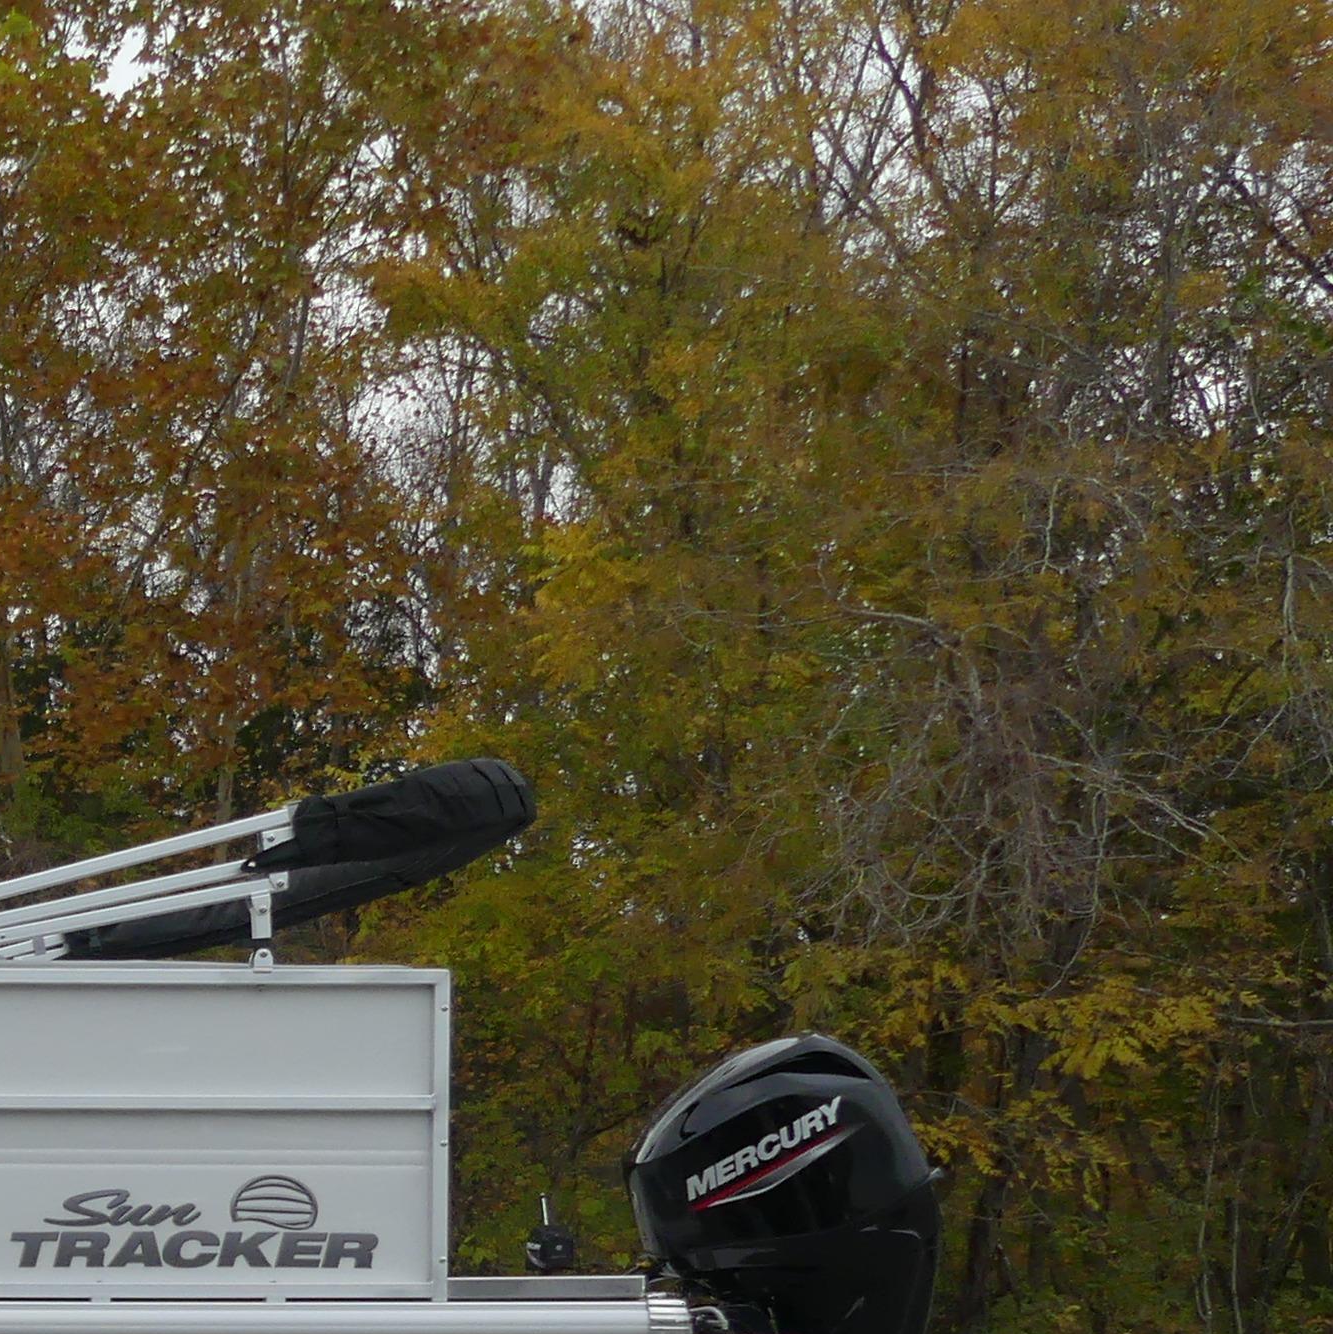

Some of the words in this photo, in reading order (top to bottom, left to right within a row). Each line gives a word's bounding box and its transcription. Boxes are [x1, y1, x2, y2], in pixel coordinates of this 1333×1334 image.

[685, 1096, 842, 1201] MERCURY
[43, 1188, 202, 1226] Sun
[10, 1231, 379, 1269] TRACKER
